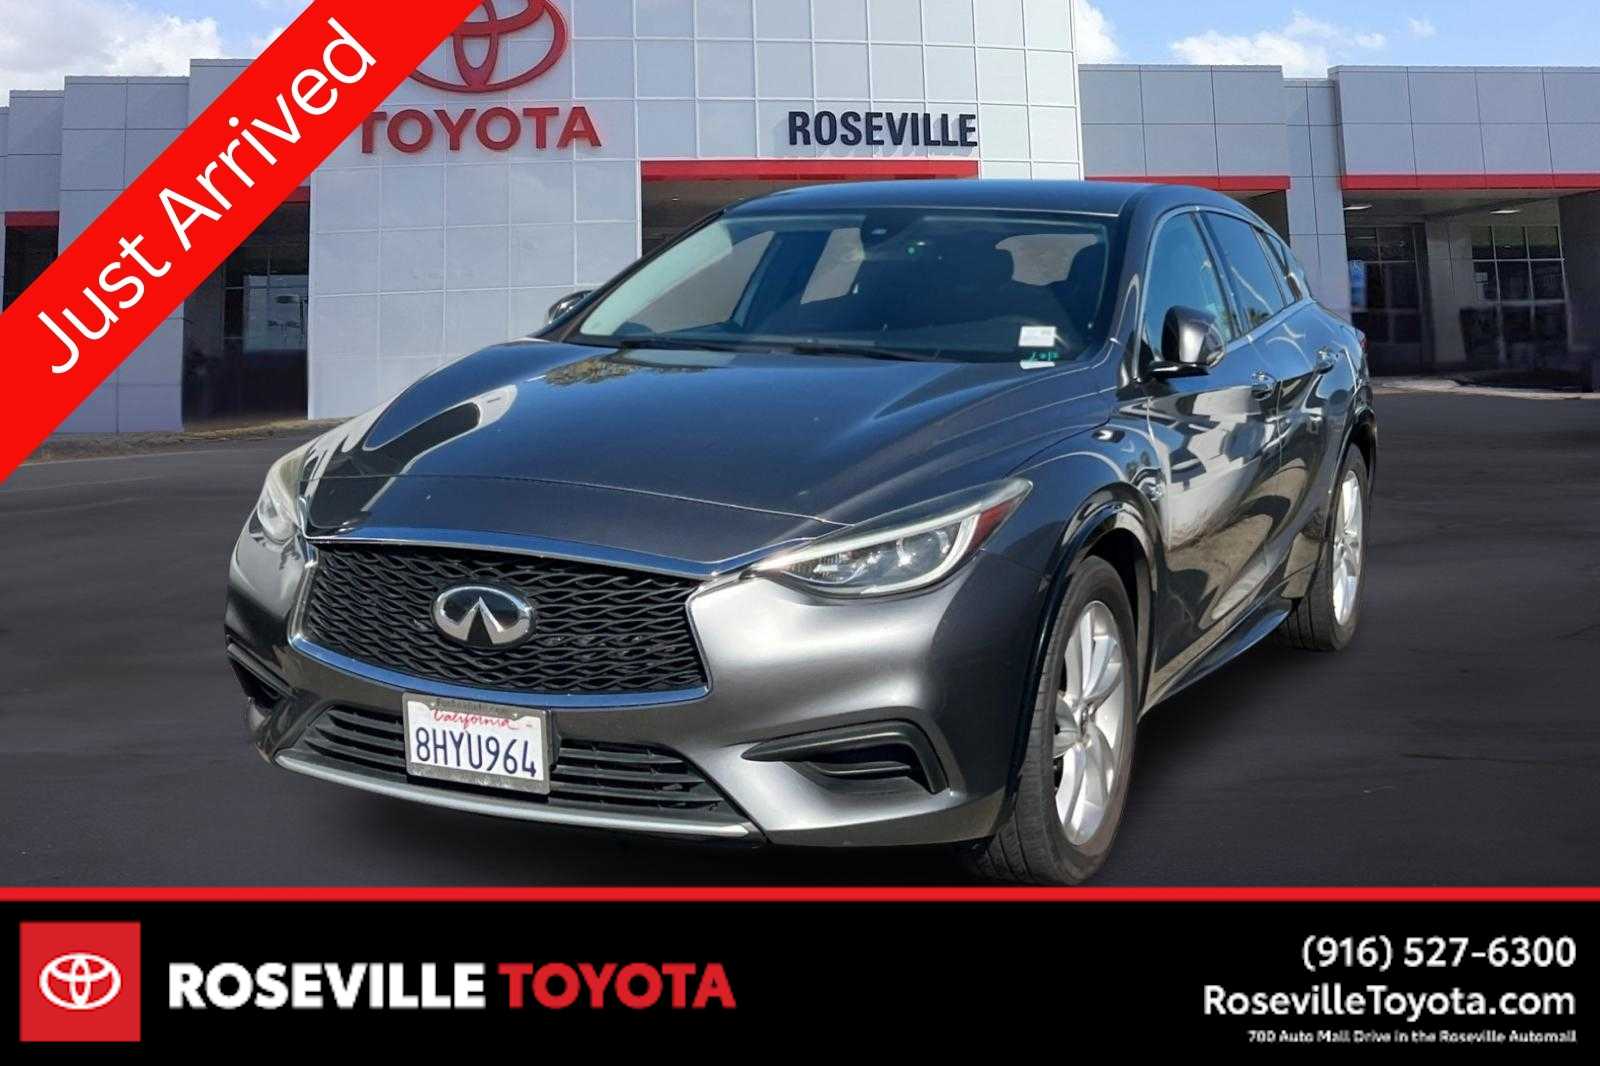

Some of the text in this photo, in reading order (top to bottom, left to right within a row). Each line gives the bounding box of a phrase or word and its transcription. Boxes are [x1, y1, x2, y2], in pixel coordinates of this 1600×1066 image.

[361, 106, 602, 154] TOYOTA
[788, 111, 978, 146] ROSEVILLE
[415, 727, 537, 777] 8HYU964
